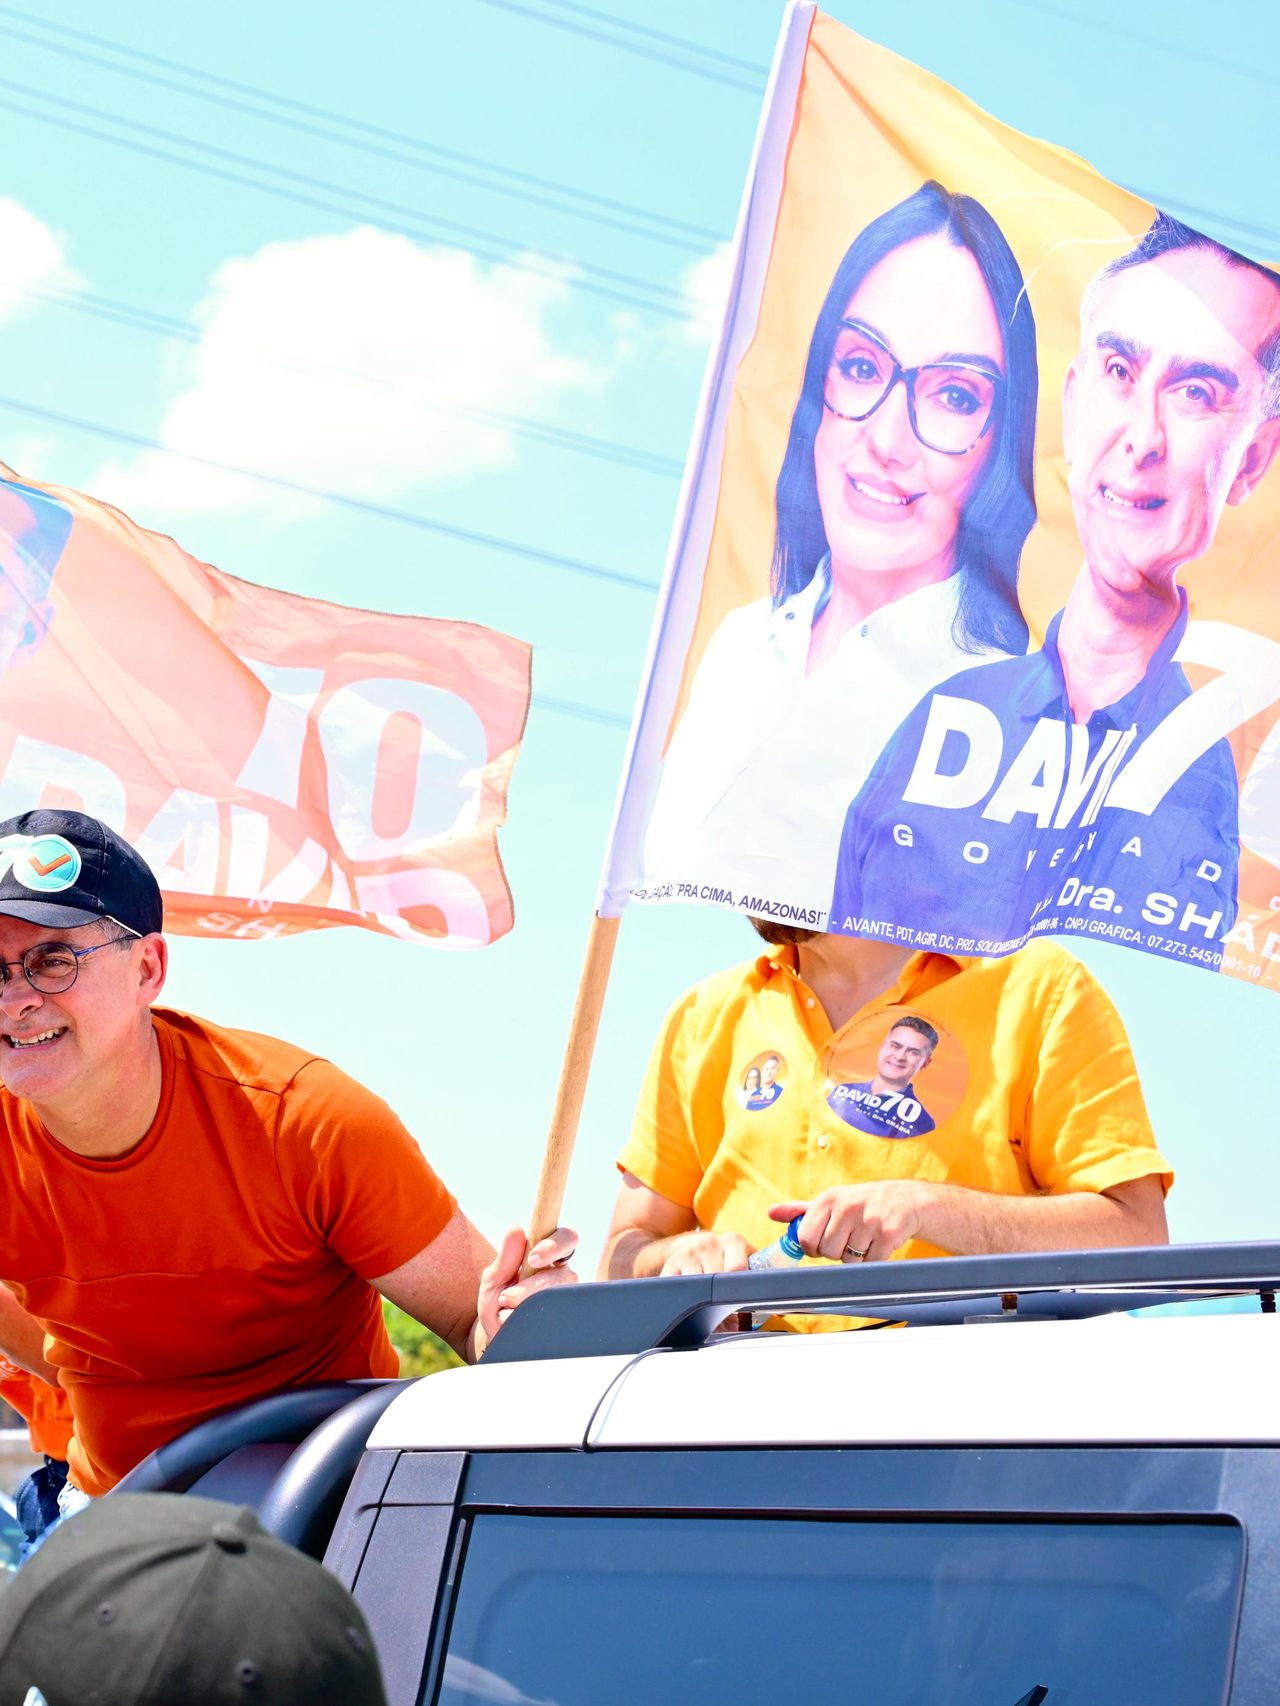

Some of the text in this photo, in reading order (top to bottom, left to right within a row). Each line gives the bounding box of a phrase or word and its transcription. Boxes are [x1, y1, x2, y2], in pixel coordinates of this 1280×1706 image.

[700, 885, 736, 908] CIMA,
[1056, 877, 1124, 915] Dra.
[842, 916, 895, 939] AVANTE,
[896, 925, 914, 944] PDT,
[914, 930, 938, 949] AGIR,
[939, 934, 954, 951] DC,
[955, 938, 975, 953] PRD,
[1065, 917, 1087, 931] CNPJ
[1088, 920, 1145, 945] GRAFICA:
[834, 1086, 882, 1108] DAVID
[879, 1090, 922, 1123] 70
